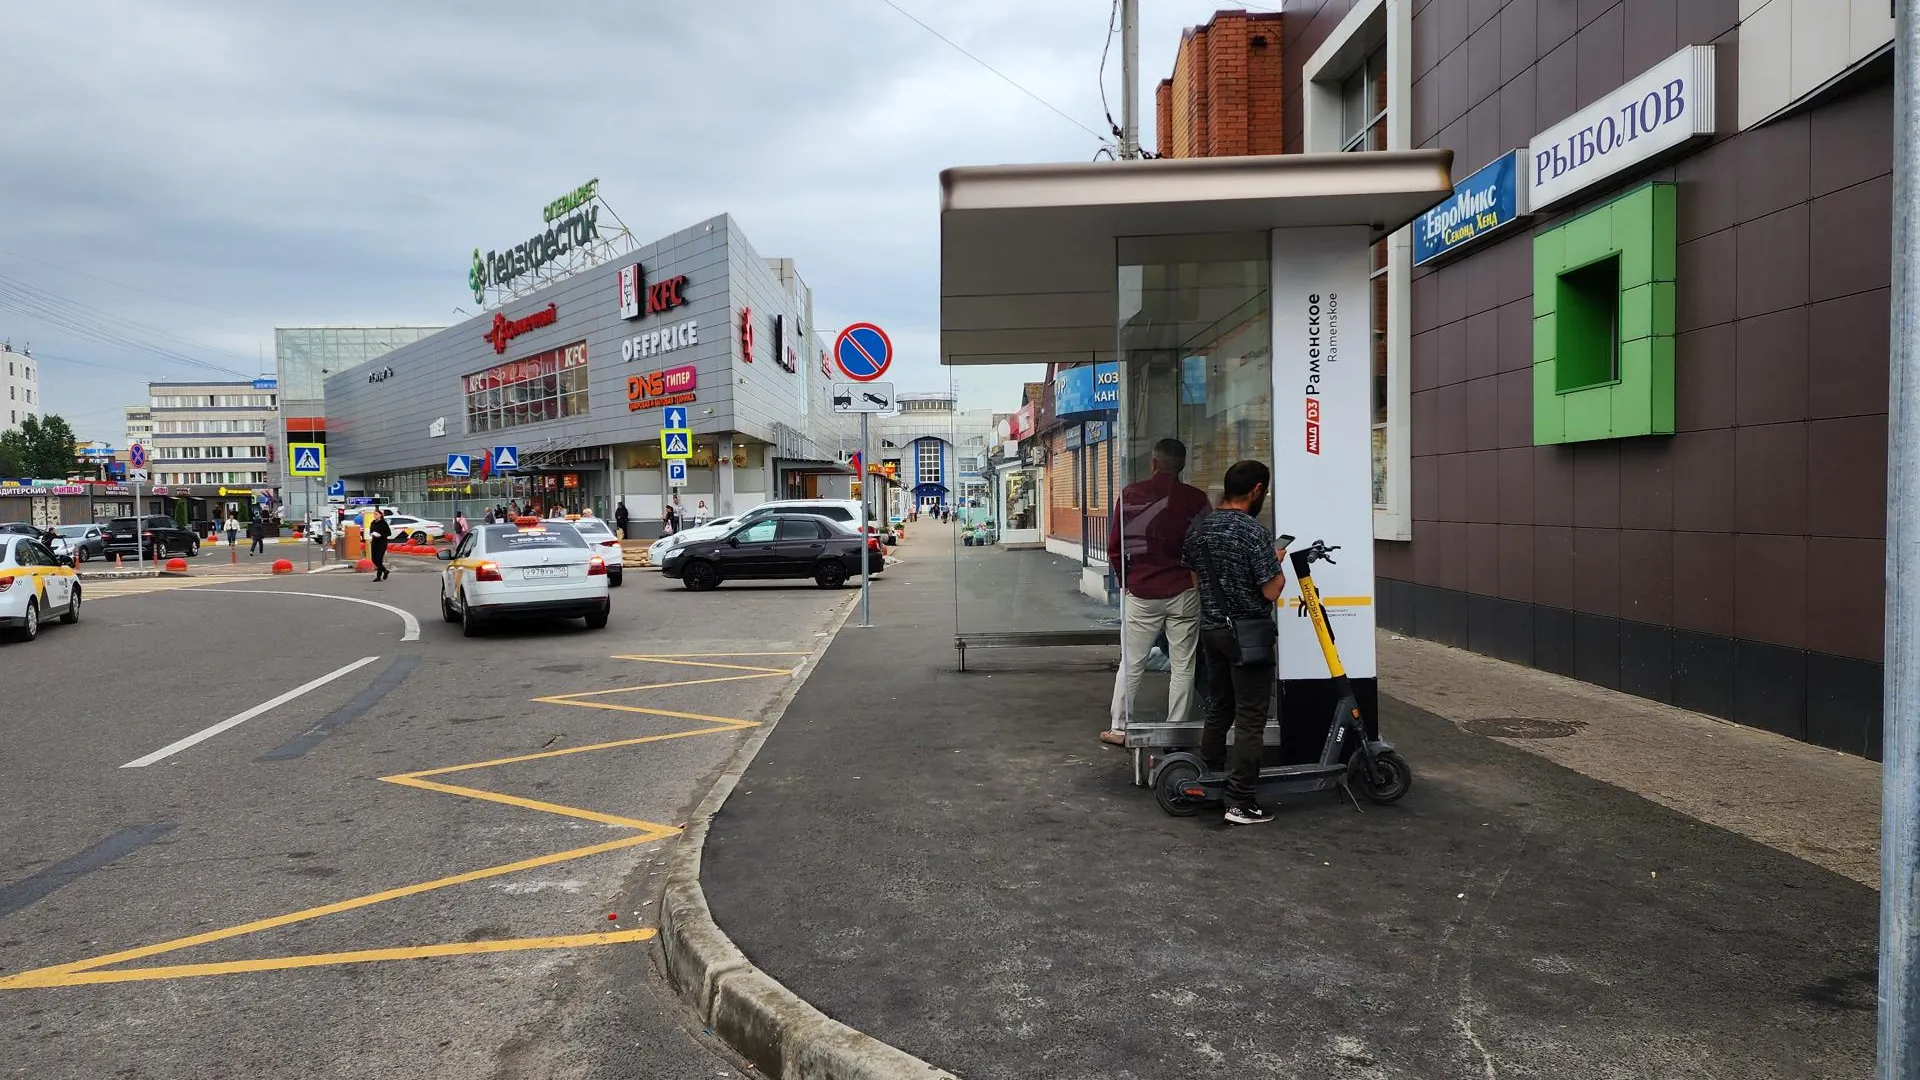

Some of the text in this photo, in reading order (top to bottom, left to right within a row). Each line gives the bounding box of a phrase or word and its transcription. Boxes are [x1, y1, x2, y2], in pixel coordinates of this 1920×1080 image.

[1535, 78, 1686, 188] РЫБОЛОВ
[647, 275, 686, 314] KFC
[621, 320, 699, 362] OFFPRICE
[1306, 293, 1320, 395] Раменское
[1326, 292, 1338, 362] Ramenskoe
[564, 344, 586, 367] KFC
[469, 373, 484, 392] KFC
[627, 371, 691, 400] DNS ГИПЕР
[0, 485, 47, 496] ДИТЕРСКИЙ
